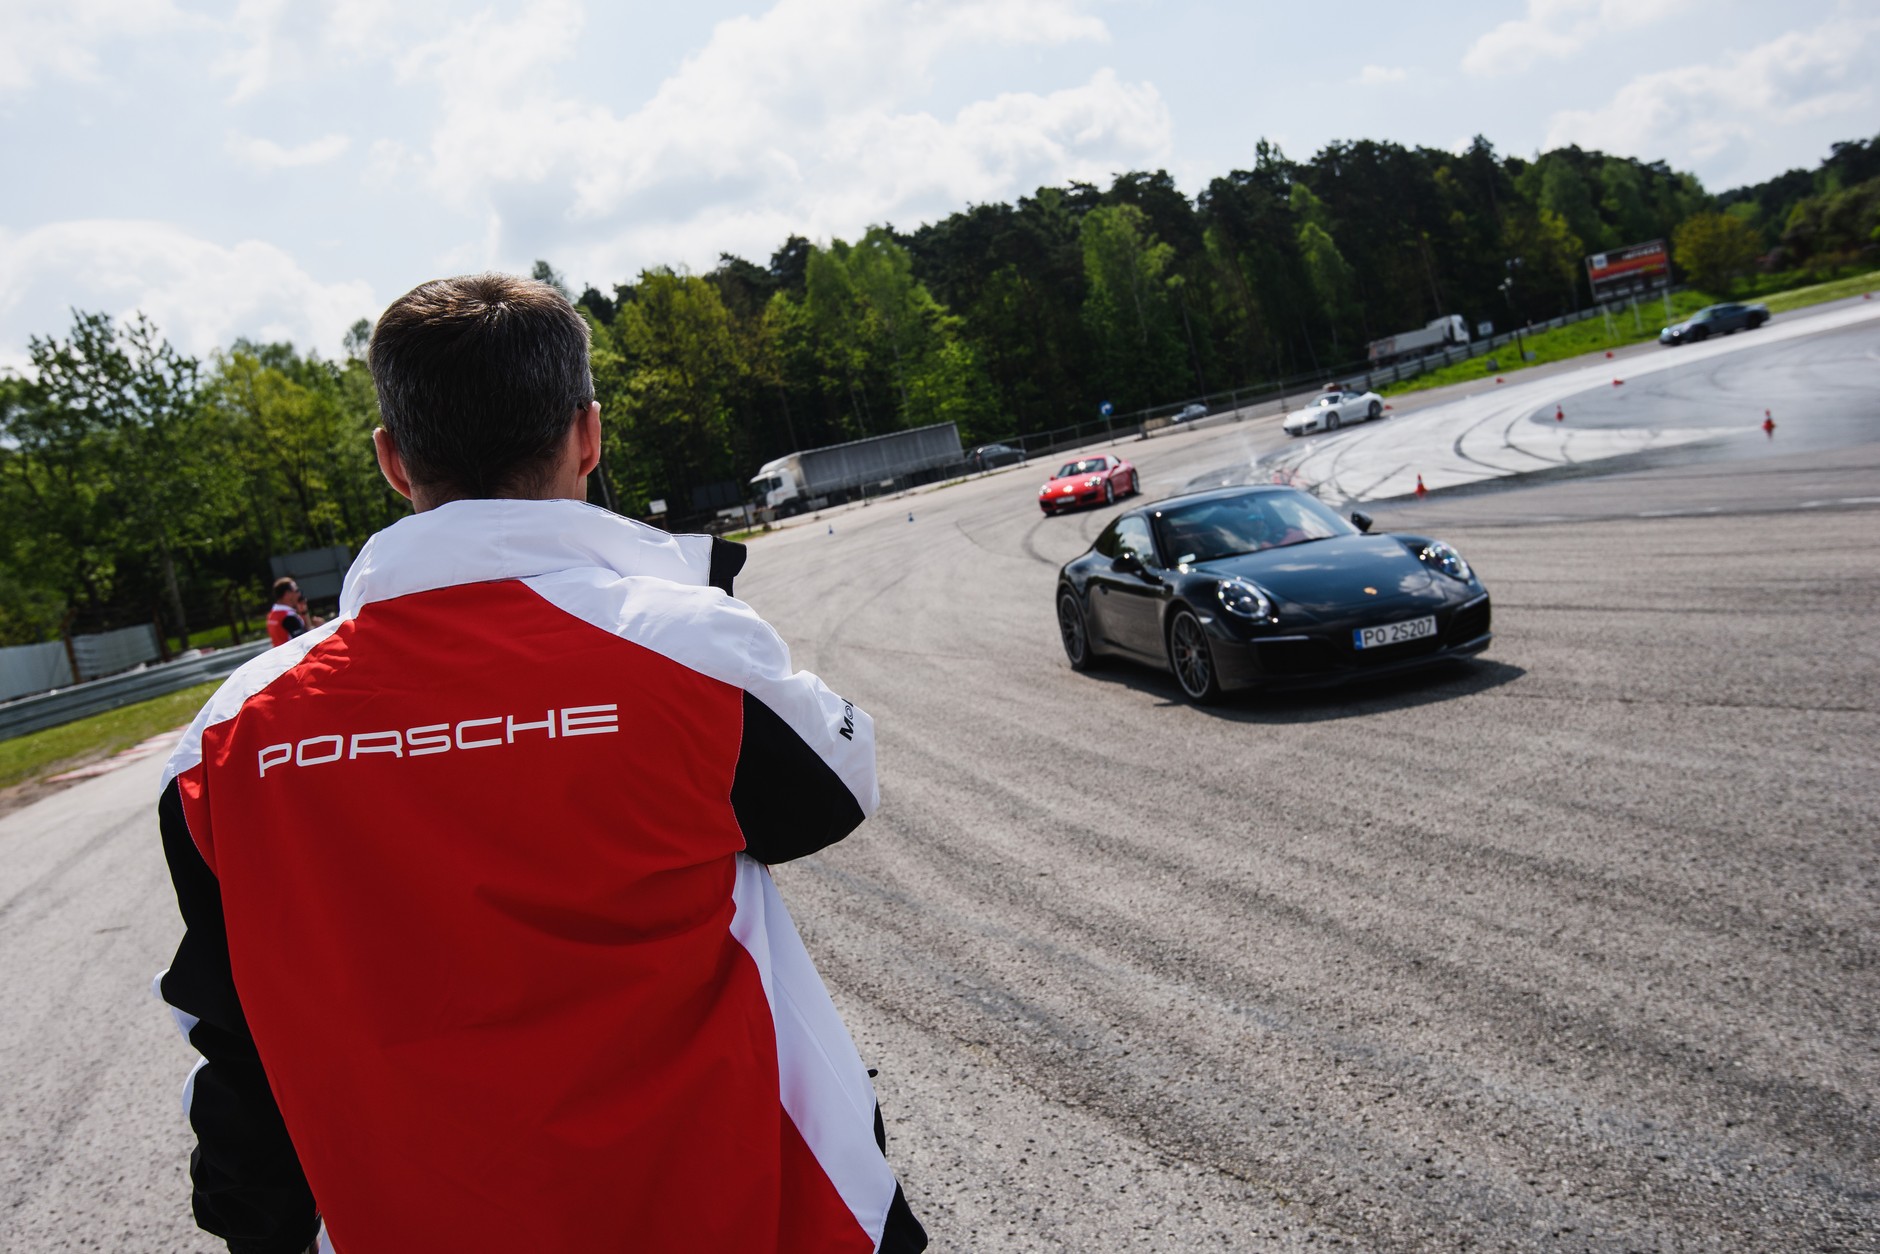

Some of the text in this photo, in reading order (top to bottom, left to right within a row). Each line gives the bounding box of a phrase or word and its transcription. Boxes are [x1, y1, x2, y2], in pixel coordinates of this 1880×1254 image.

[1364, 618, 1433, 646] PO 2S207
[258, 703, 619, 778] PORSCHE
[839, 698, 854, 741] Mo
